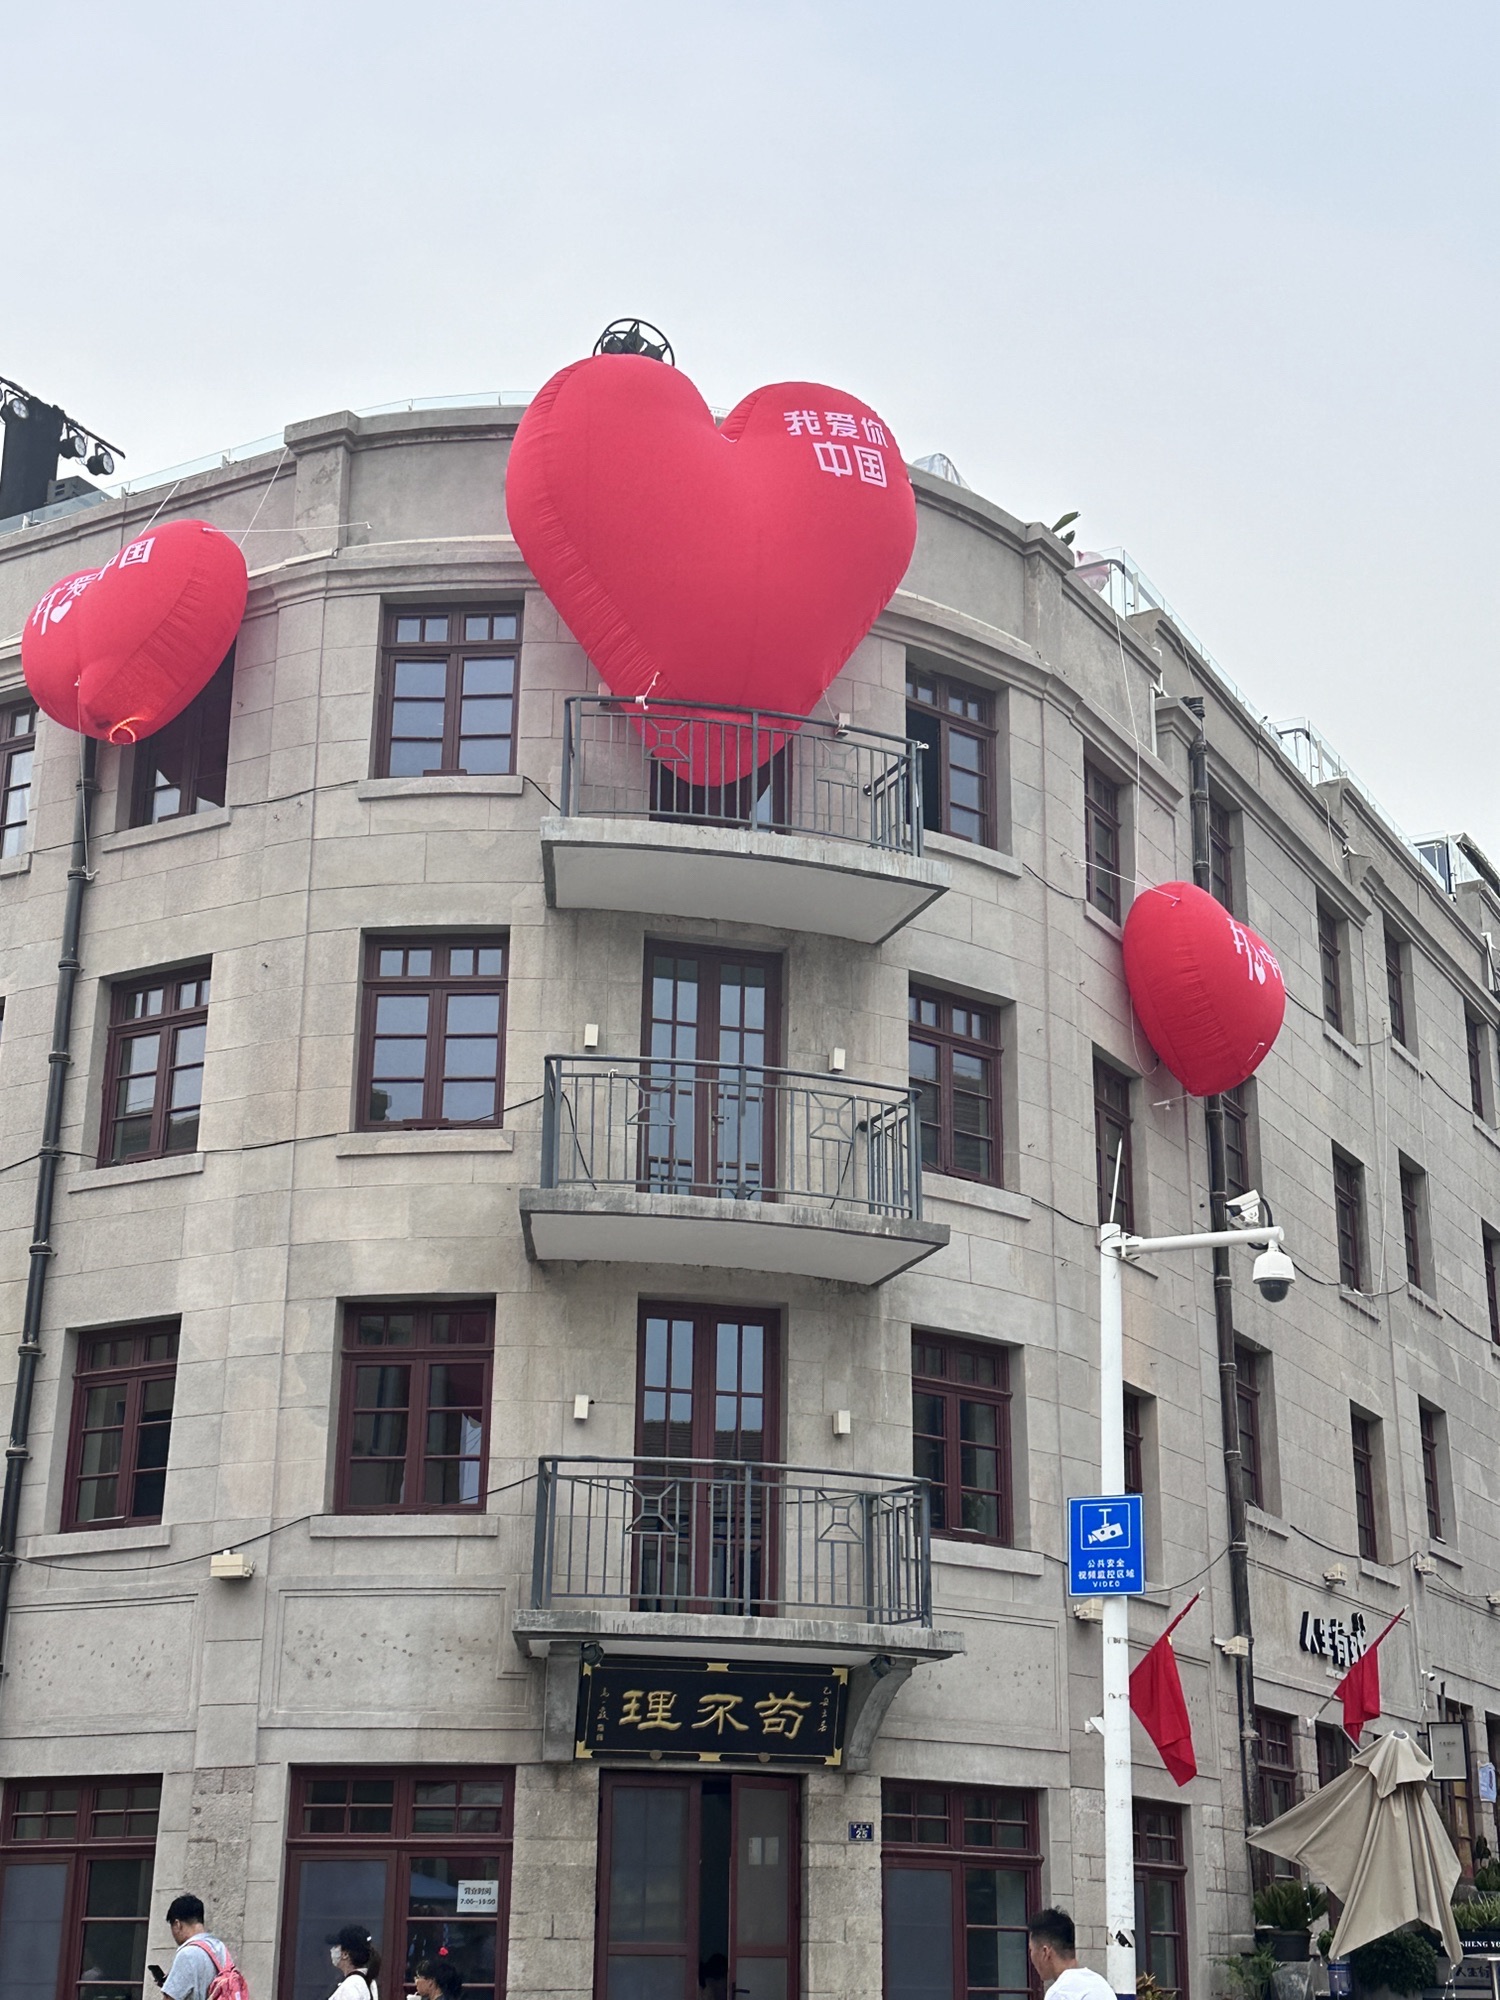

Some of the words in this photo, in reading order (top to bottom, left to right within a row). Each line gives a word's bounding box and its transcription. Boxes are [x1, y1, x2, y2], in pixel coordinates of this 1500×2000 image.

[783, 410, 888, 448] 我爱你
[812, 441, 887, 488] 中国
[1088, 1558, 1125, 1568] 公共安全
[1078, 1569, 1135, 1580] 视频监控区域
[1093, 1580, 1120, 1588] VIDEO
[856, 1830, 868, 1839] 25
